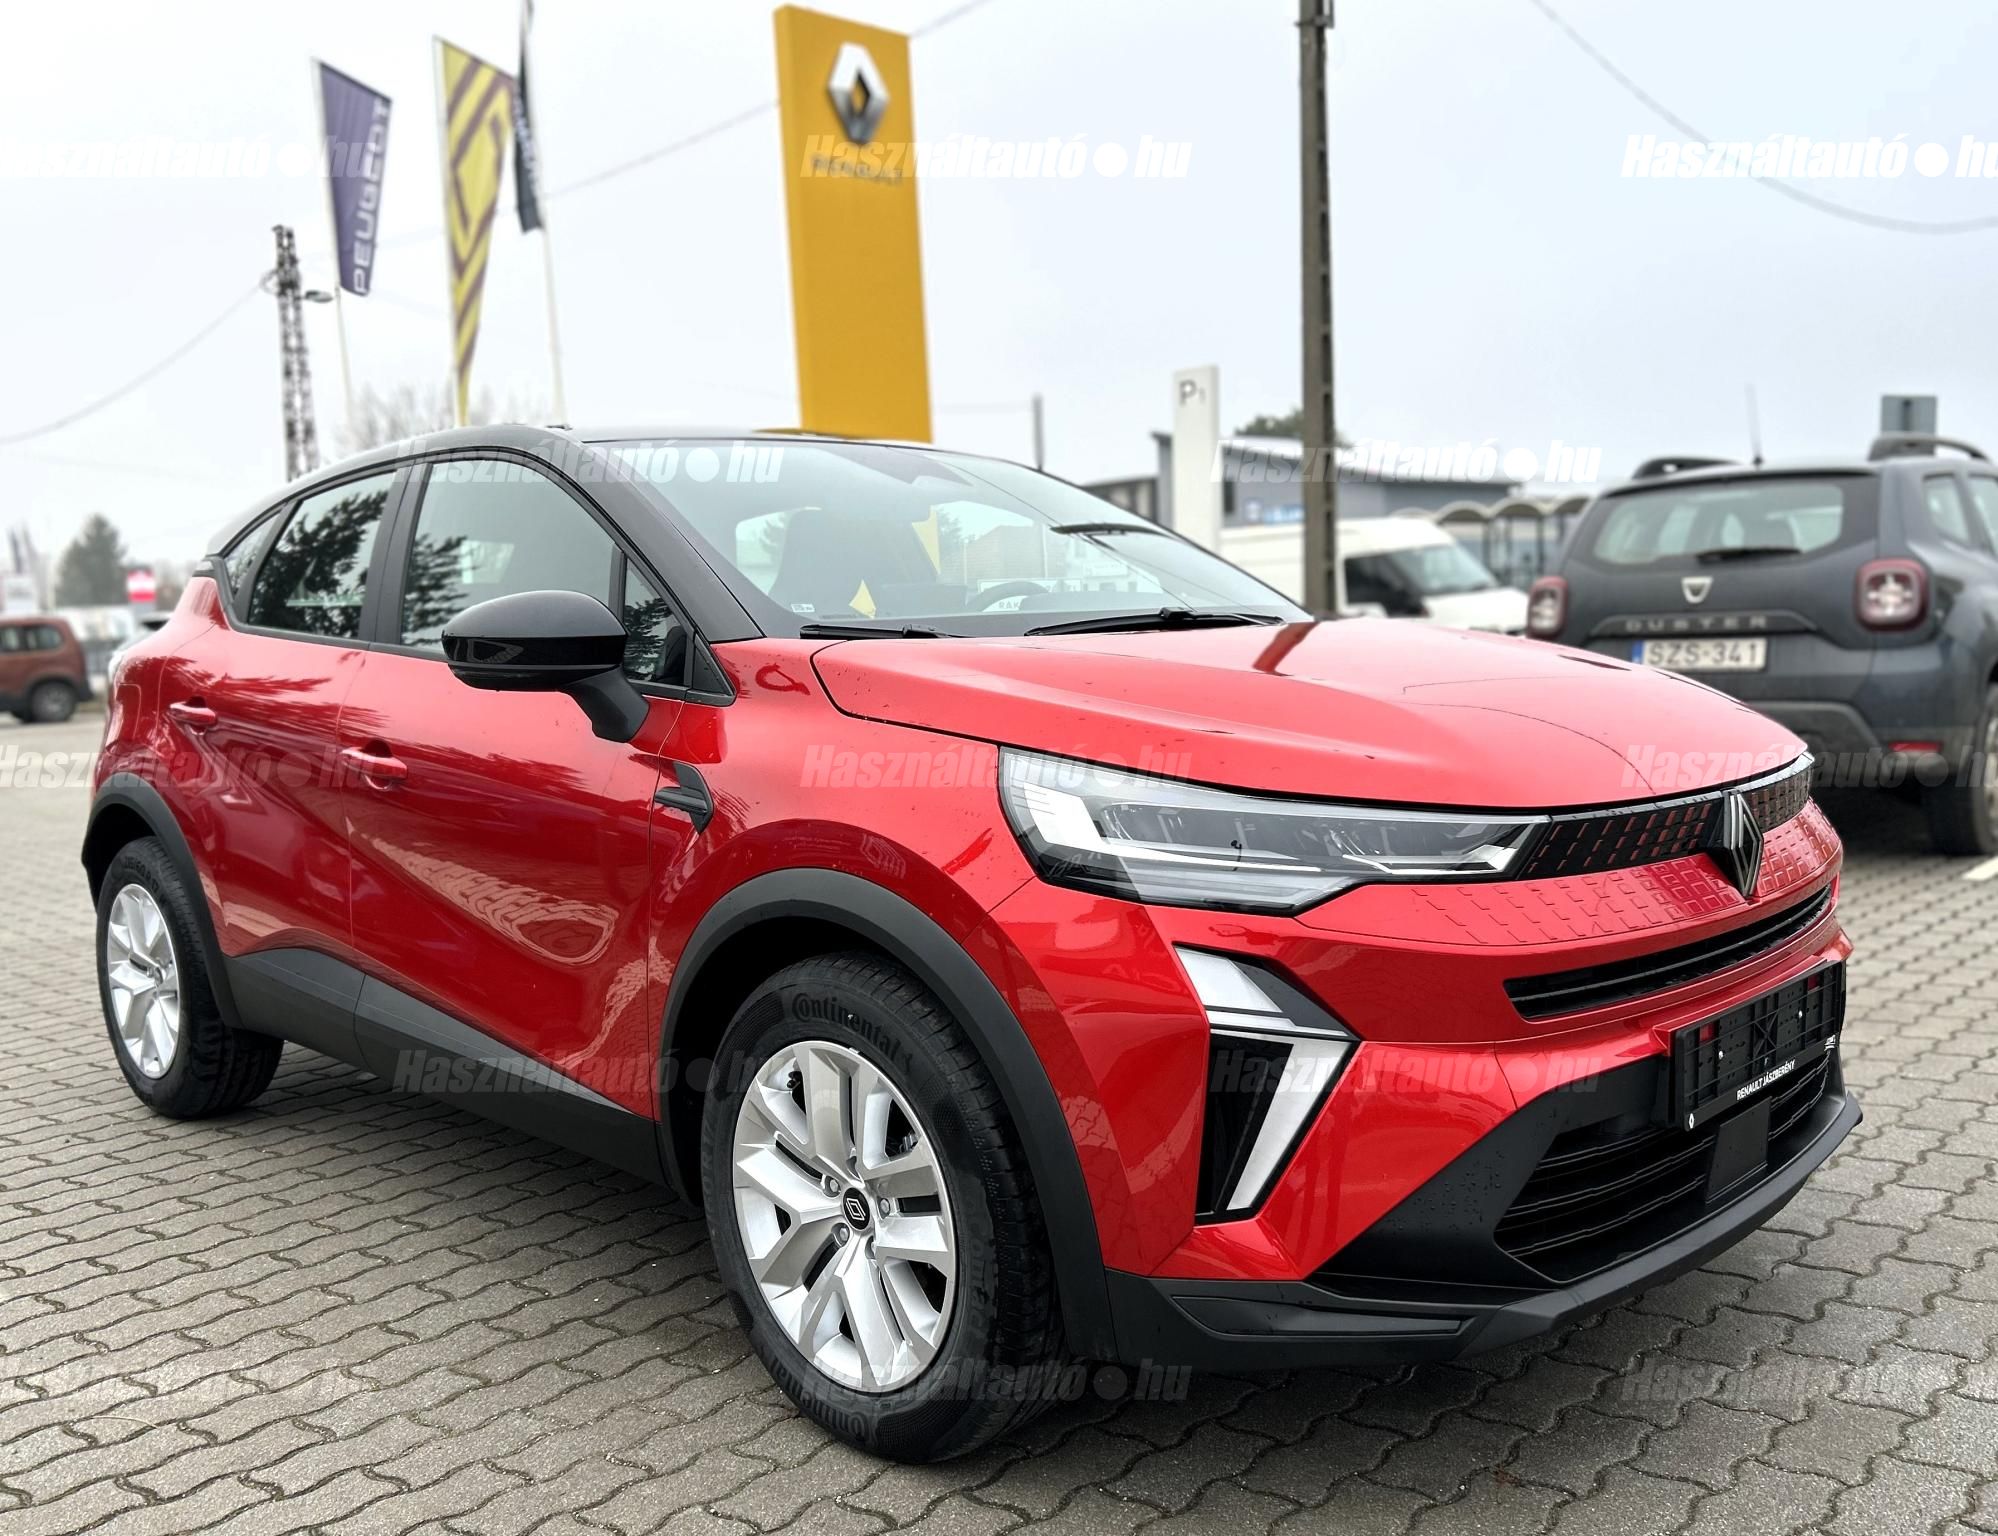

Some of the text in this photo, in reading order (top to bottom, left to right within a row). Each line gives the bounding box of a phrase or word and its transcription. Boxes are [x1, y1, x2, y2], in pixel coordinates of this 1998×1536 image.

[1626, 615, 1767, 632] DUSTER
[1650, 641, 1757, 665] SZS-341
[791, 992, 902, 1062] Continental
[1736, 1058, 1796, 1101] RENAULT JÁSZBERÉNY
